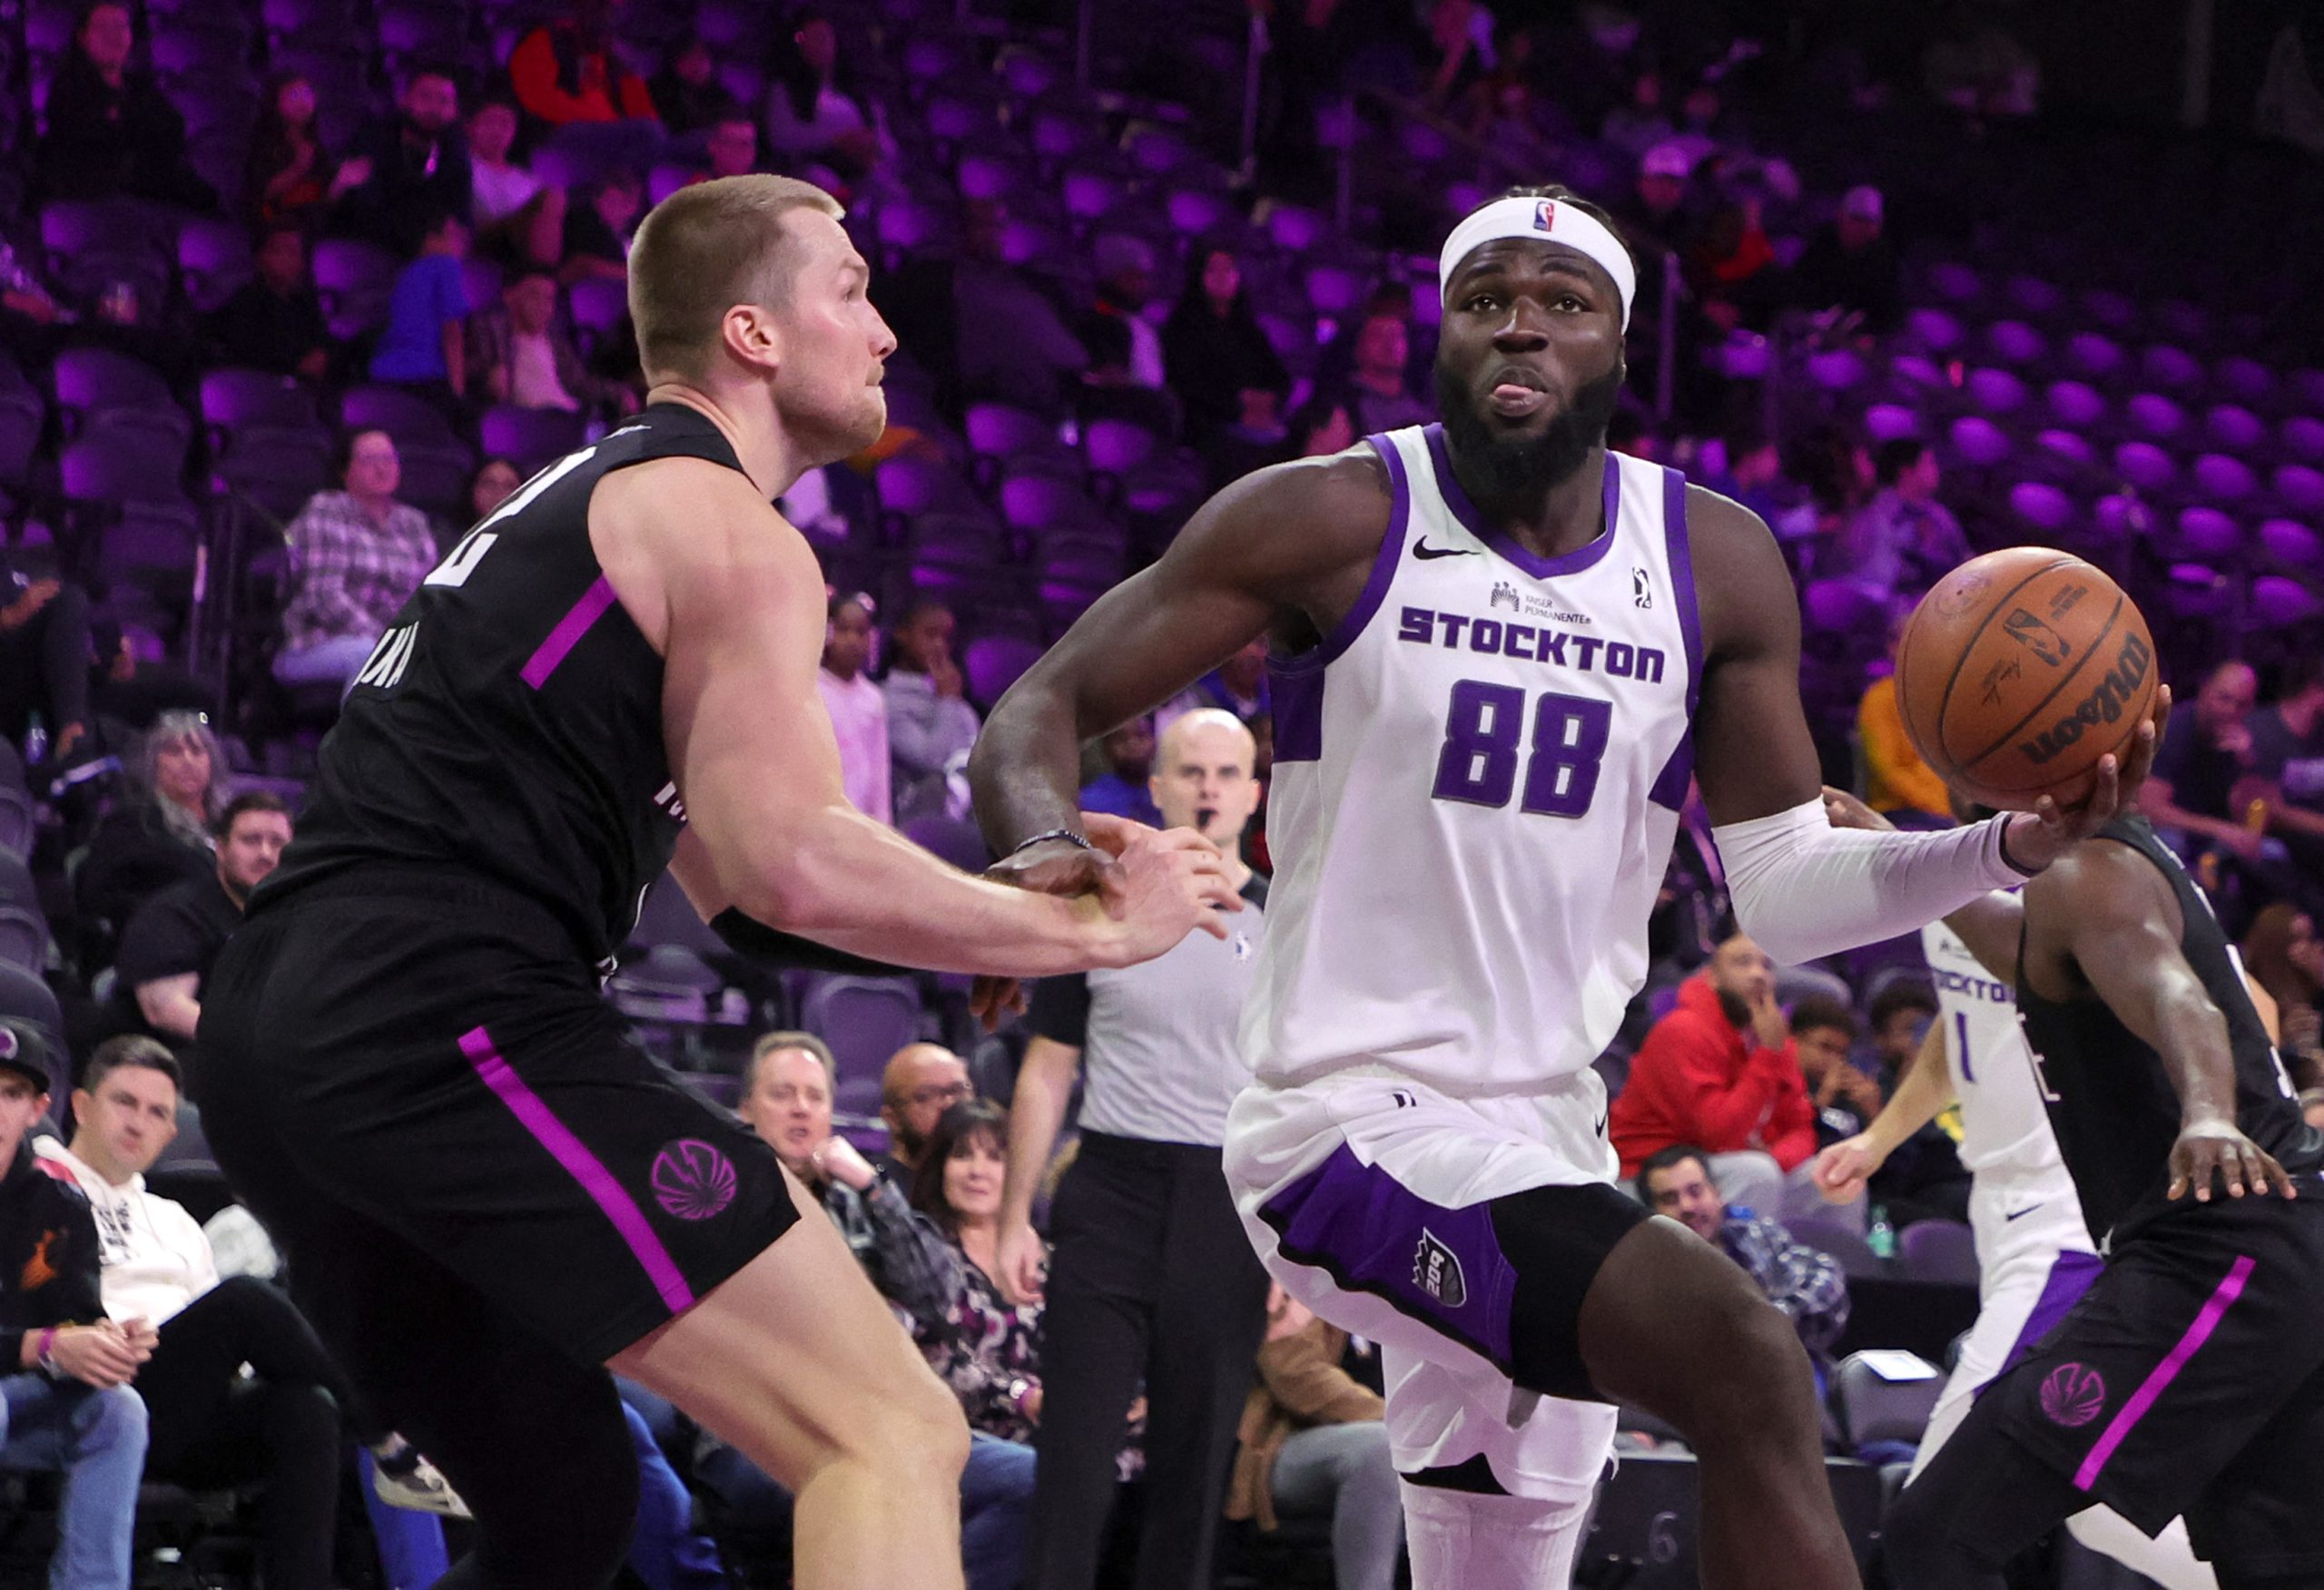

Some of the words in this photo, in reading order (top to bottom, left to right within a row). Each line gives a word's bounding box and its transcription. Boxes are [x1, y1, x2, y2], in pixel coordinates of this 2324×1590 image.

[1525, 594, 1553, 608] KAISER
[1398, 606, 1665, 684] STOCKTON
[1431, 678, 1613, 819] 88
[1425, 1249, 1445, 1298] 209
[1649, 1510, 1679, 1564] 6
